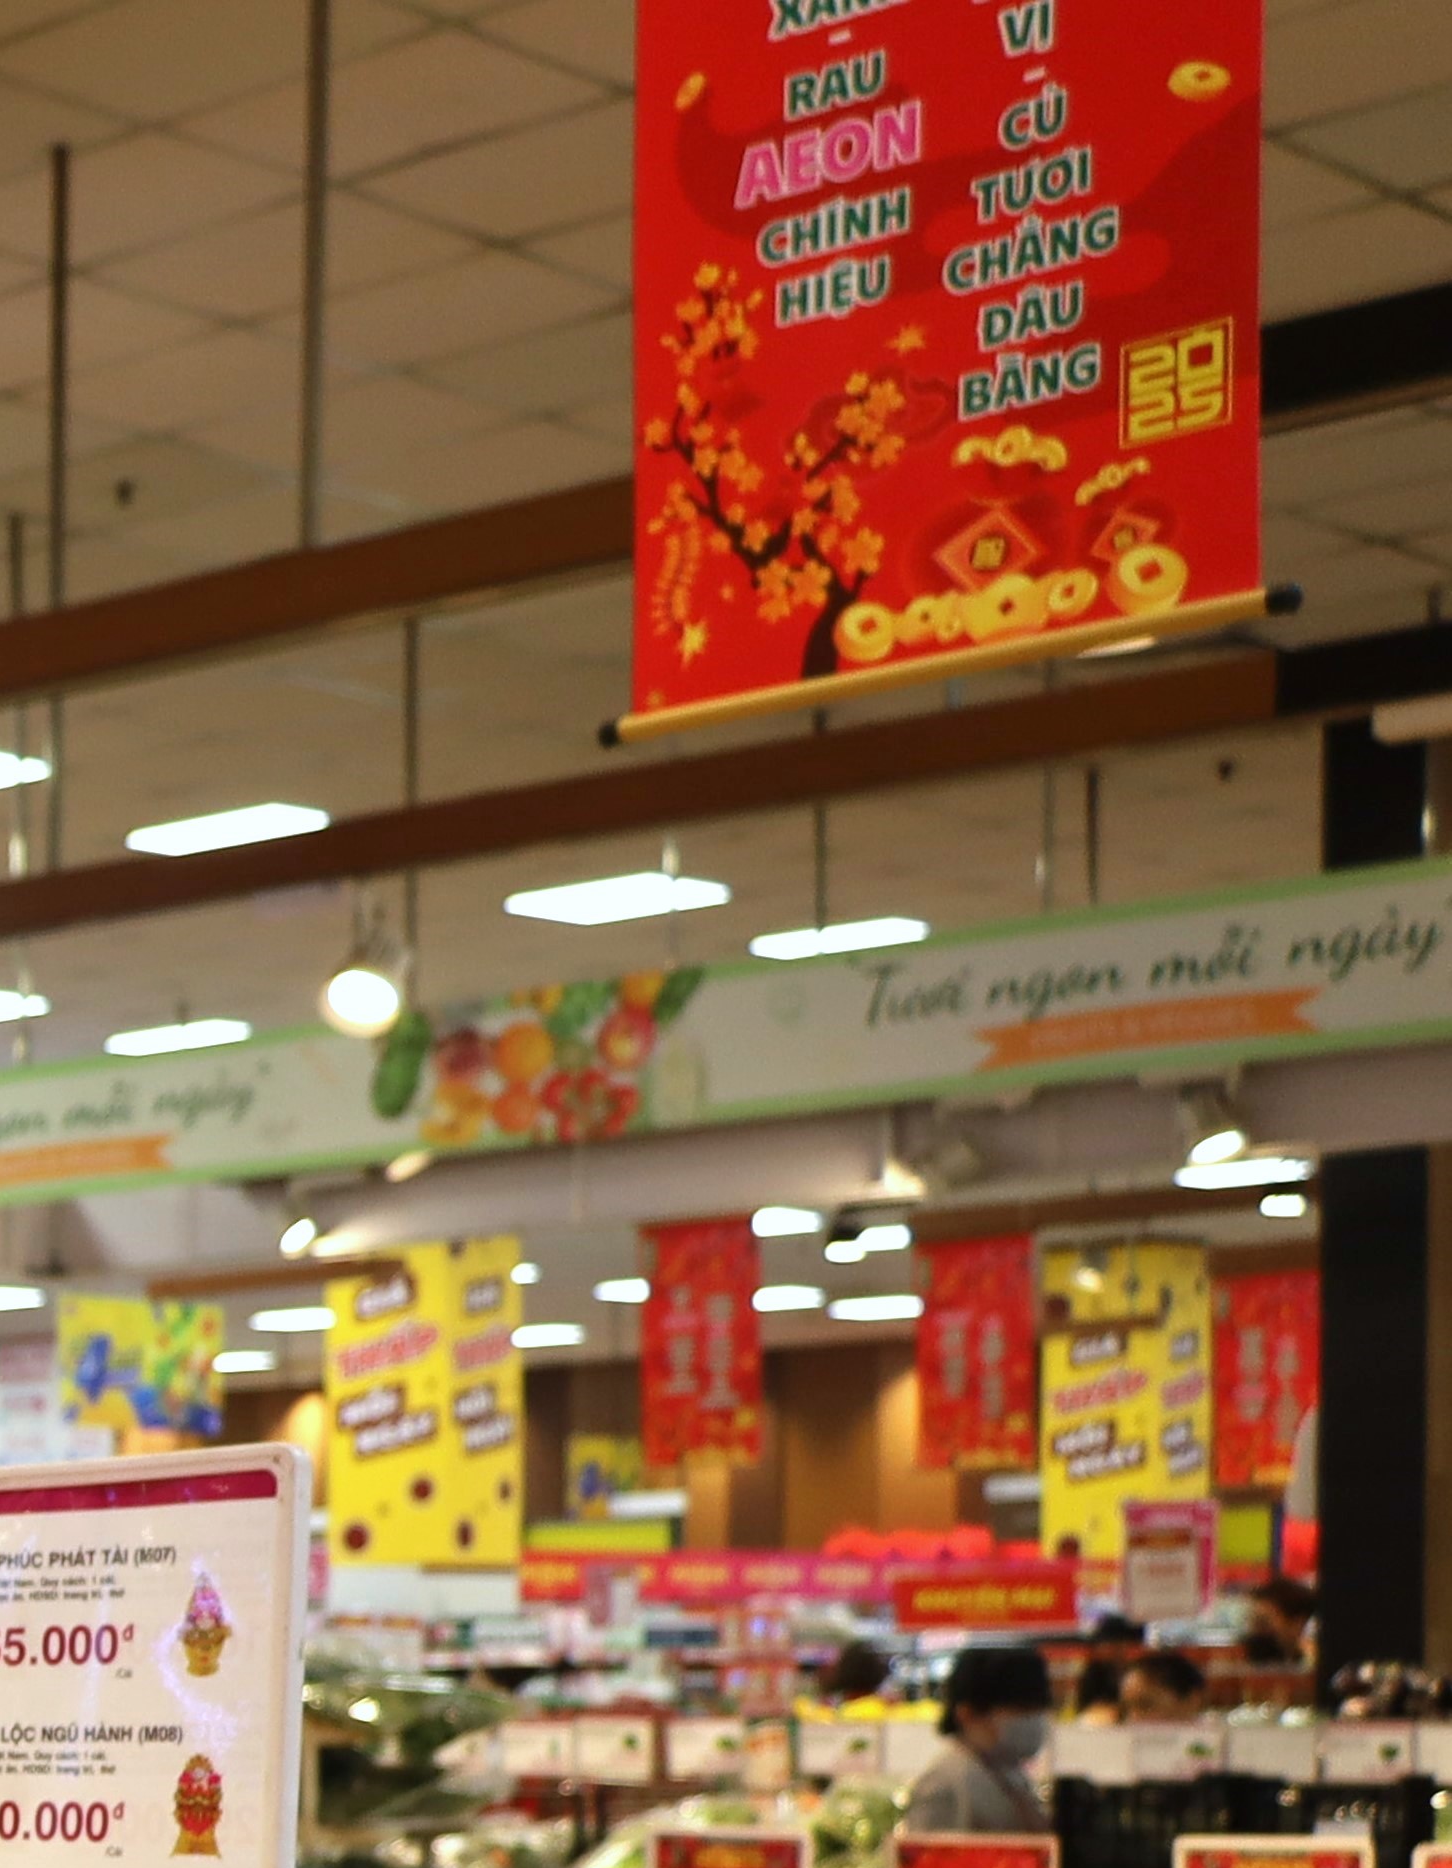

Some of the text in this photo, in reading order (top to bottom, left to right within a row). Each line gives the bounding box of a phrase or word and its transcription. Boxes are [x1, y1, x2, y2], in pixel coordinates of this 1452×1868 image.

[784, 48, 887, 123] RAU
[733, 98, 921, 210] AEON
[49, 1546, 95, 1567] PHÁT
[102, 1544, 128, 1565] TÀI
[1, 1722, 36, 1745] LỘC
[84, 1723, 132, 1742] HÀNH
